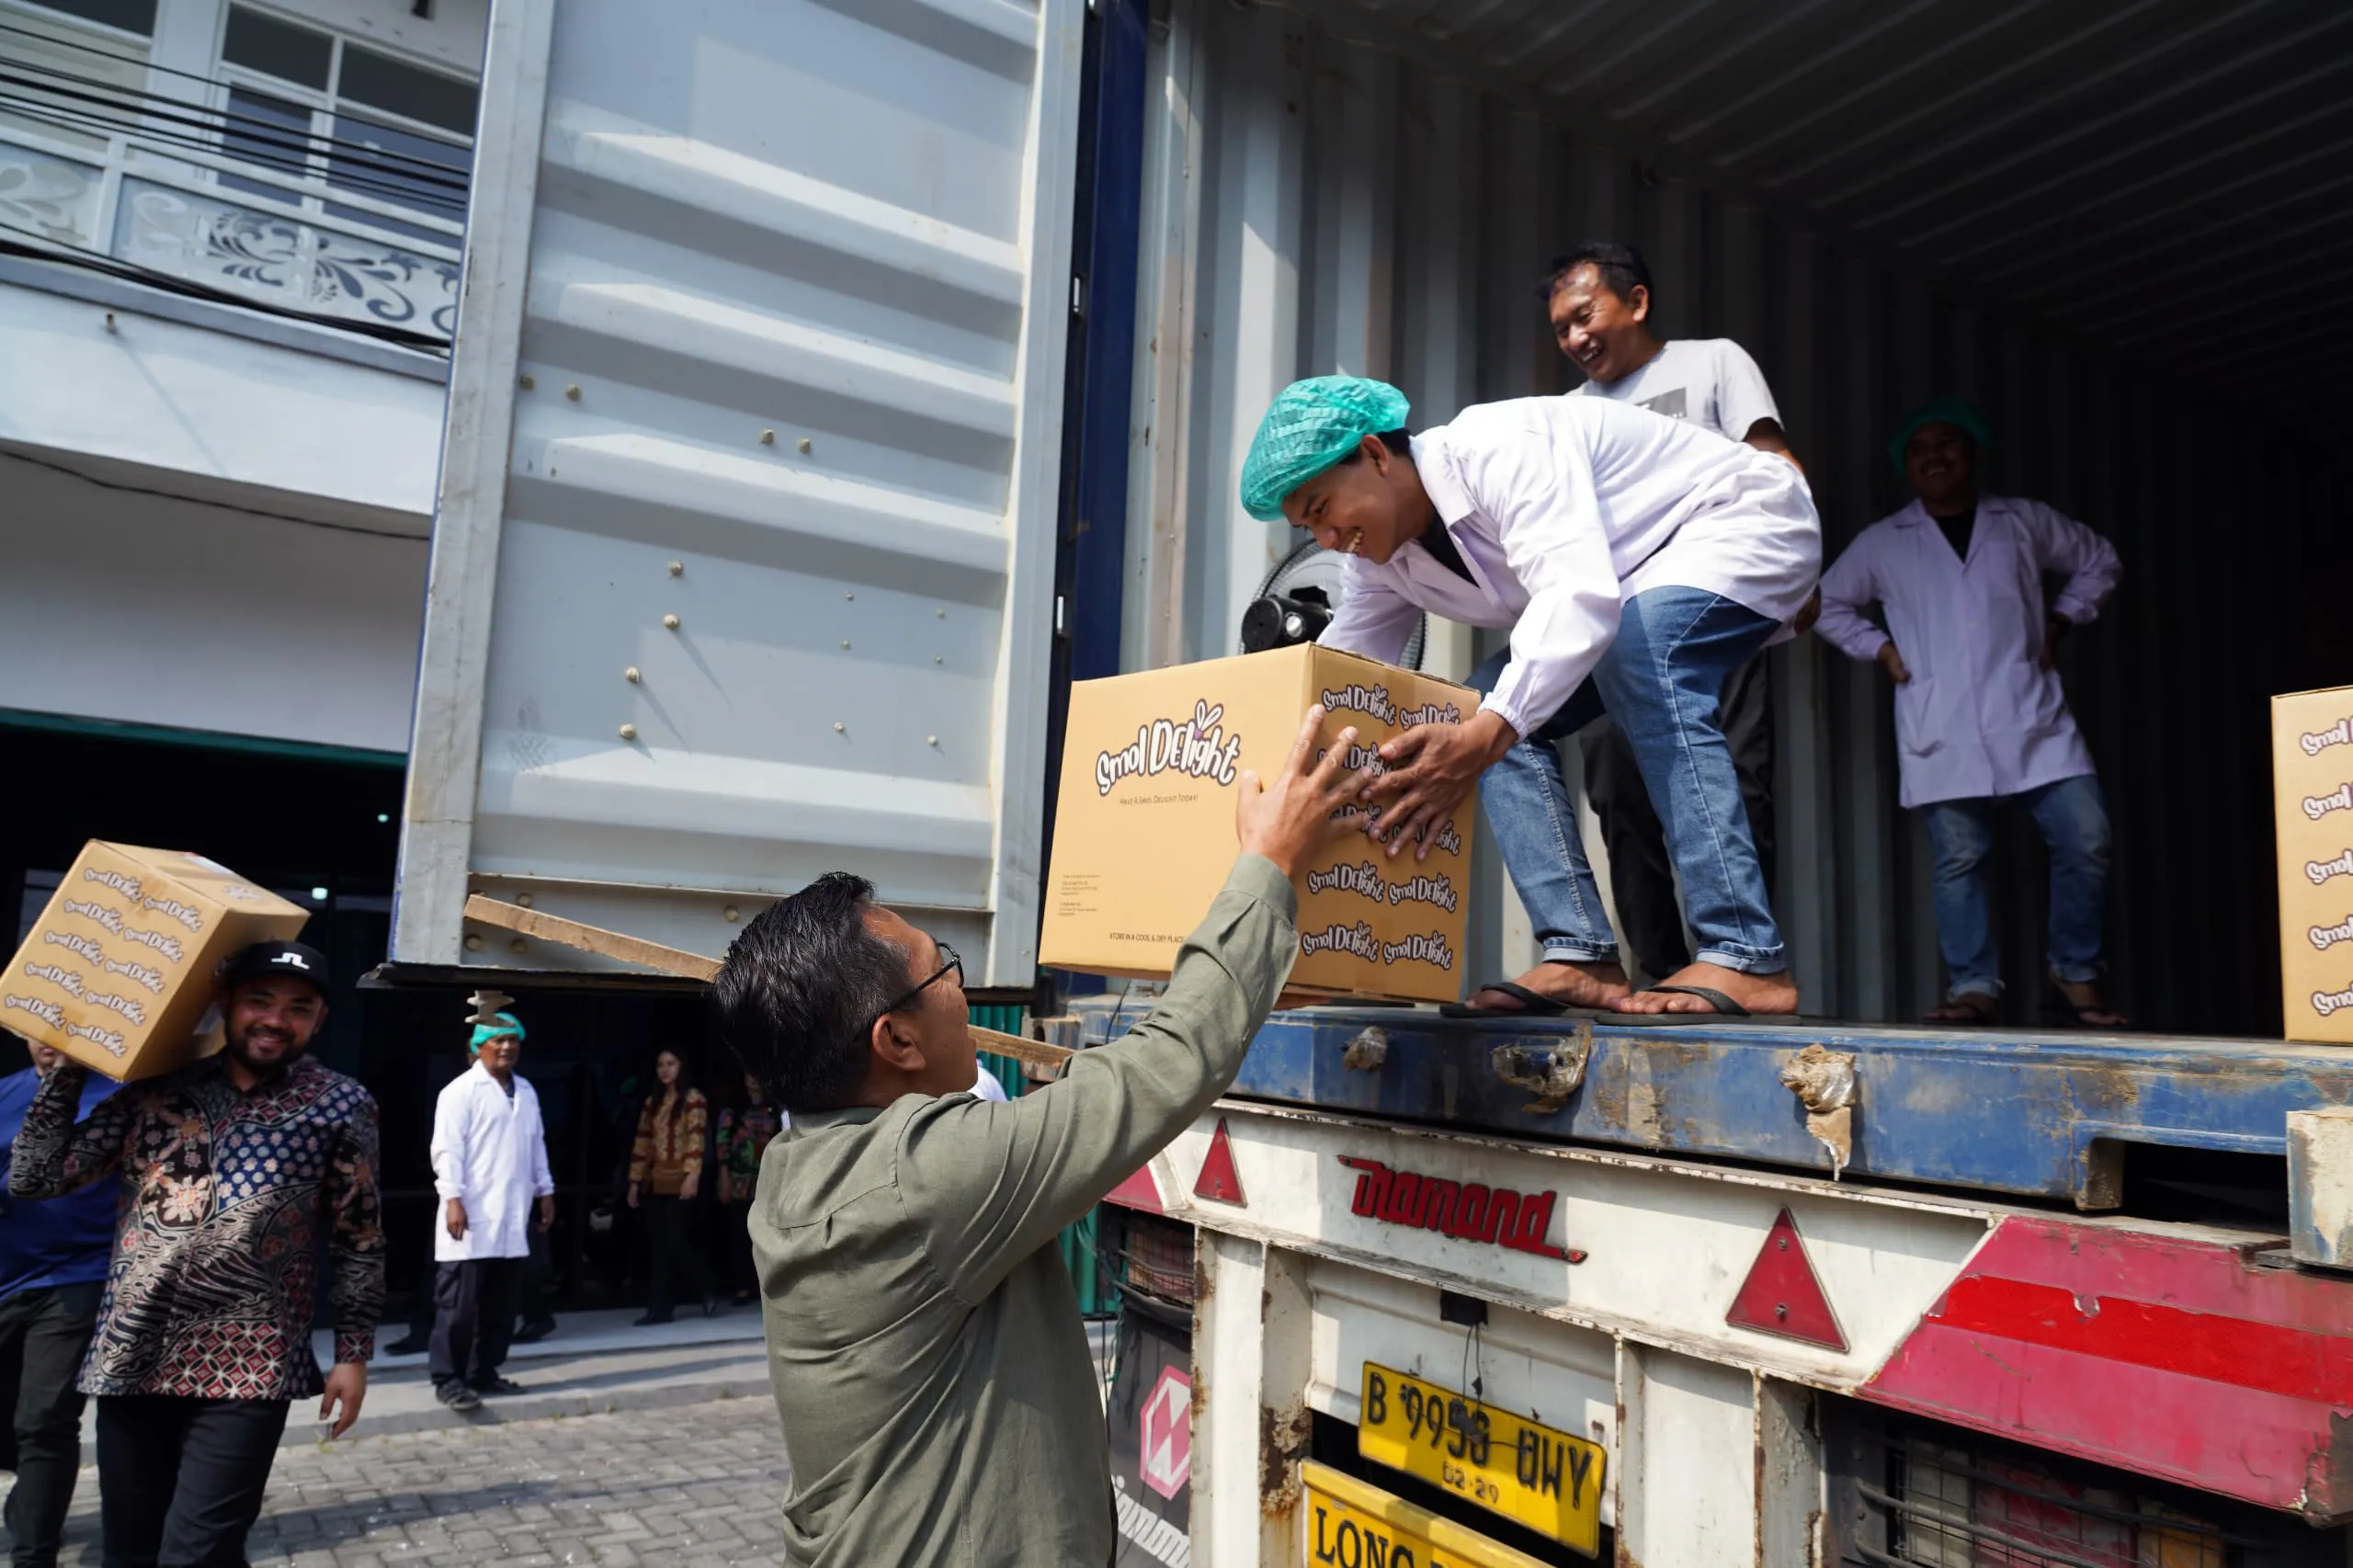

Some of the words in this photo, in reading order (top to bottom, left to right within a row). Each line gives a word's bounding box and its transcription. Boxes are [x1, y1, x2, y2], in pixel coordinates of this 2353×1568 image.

[1322, 684, 1352, 712] Smol
[1400, 703, 1427, 731] Smol
[2300, 718, 2349, 756] Smol
[1096, 724, 1148, 797] Smol
[2302, 782, 2352, 821] Smol
[1307, 863, 1339, 894] Smol
[2304, 848, 2353, 885] Smol
[1388, 875, 1417, 906] Smol
[1302, 924, 1333, 957] Smol
[1382, 934, 1412, 965] Smol
[2311, 980, 2353, 1017] Smo
[1367, 1371, 1388, 1425] B
